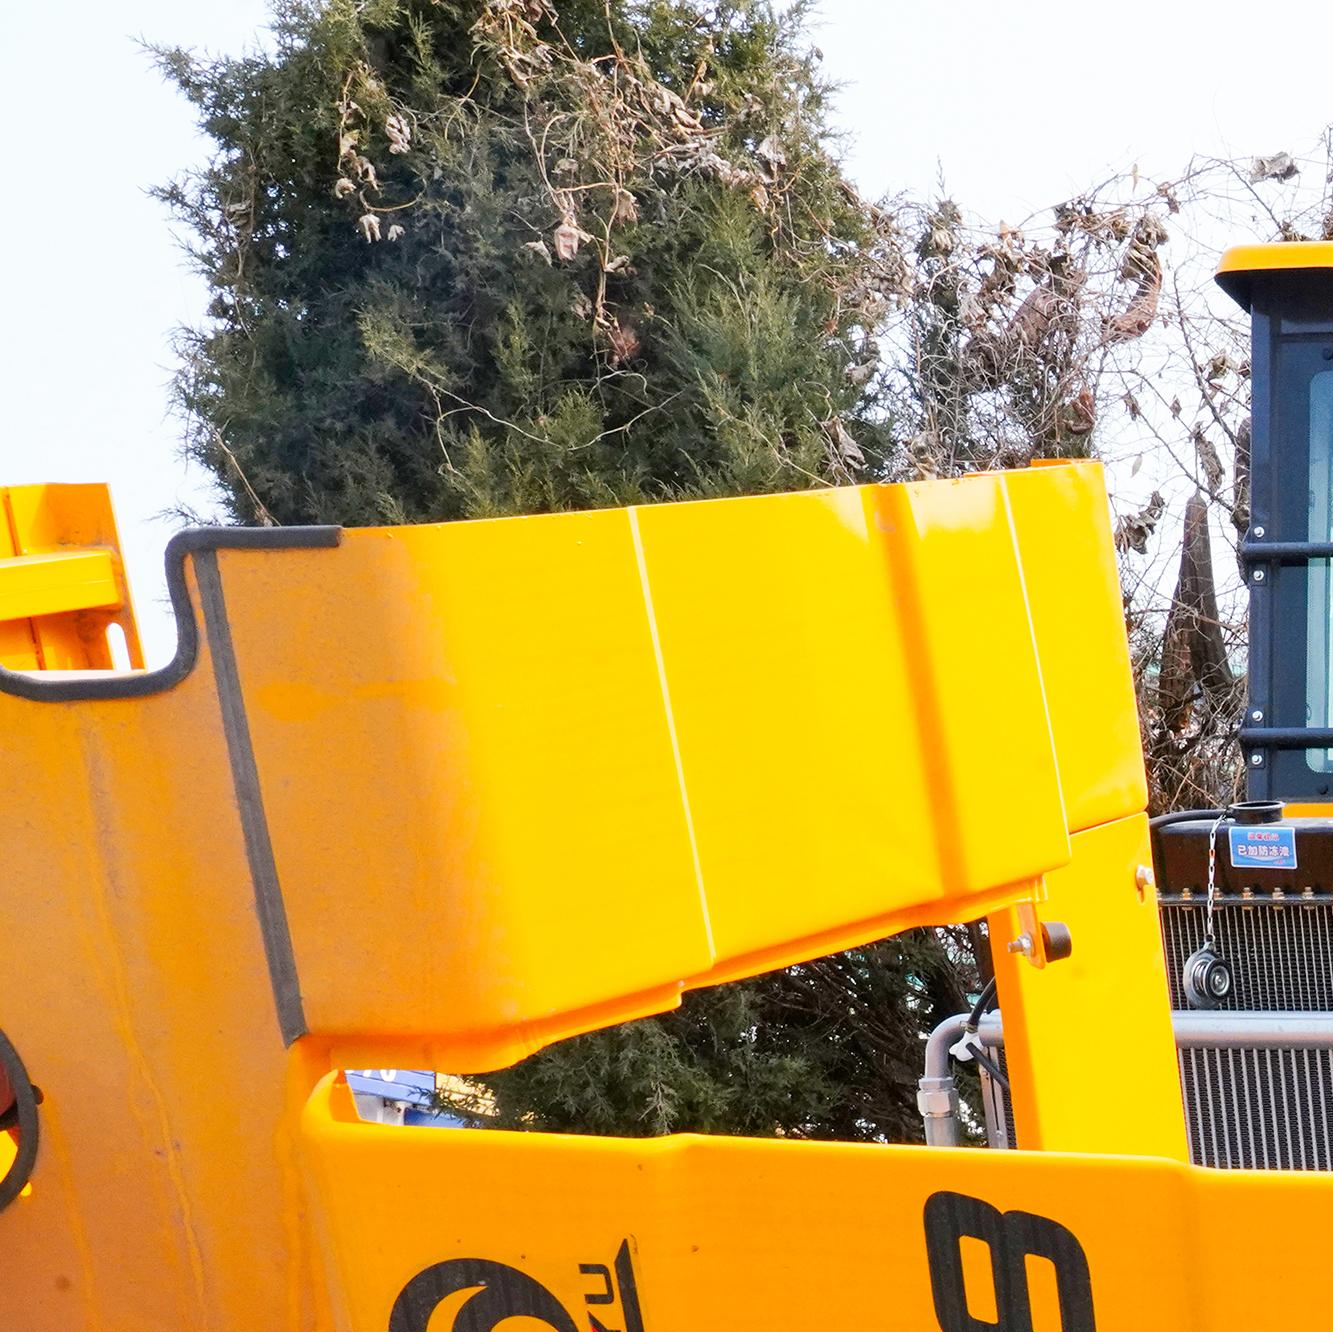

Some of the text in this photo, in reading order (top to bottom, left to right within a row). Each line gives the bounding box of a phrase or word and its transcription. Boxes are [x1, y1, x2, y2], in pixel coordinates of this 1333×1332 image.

[1237, 844, 1290, 857] 已加防冻液
